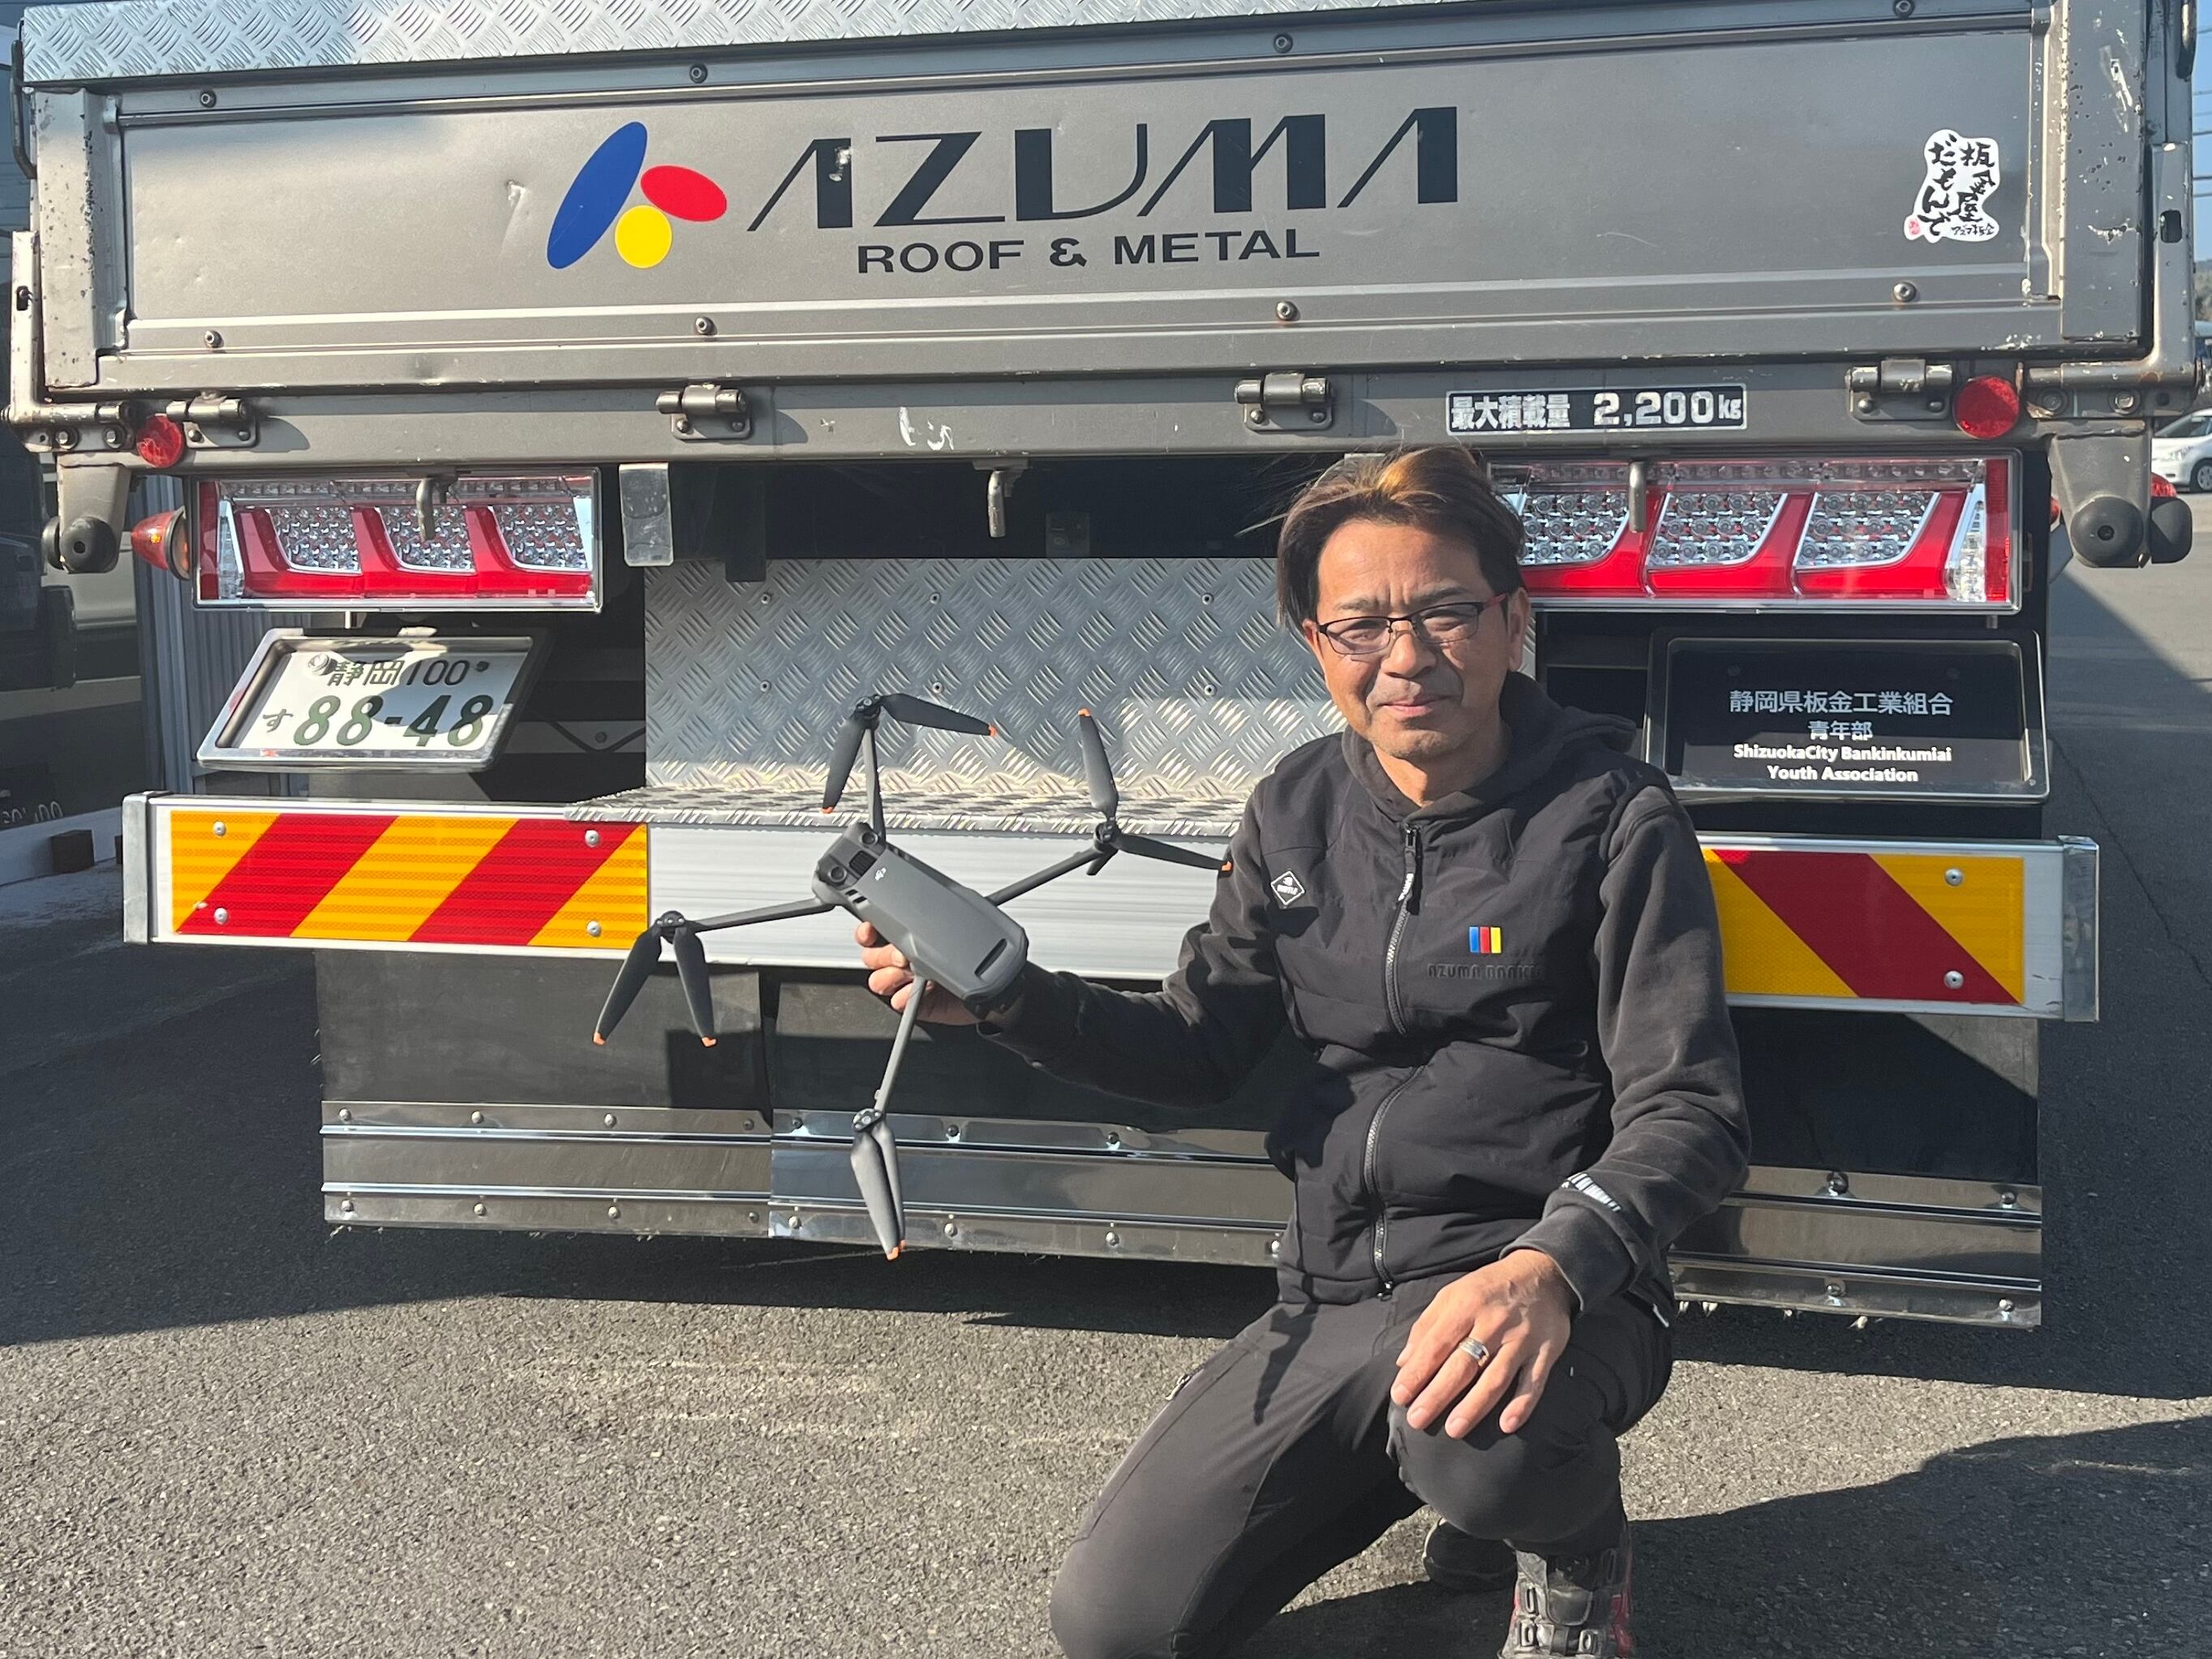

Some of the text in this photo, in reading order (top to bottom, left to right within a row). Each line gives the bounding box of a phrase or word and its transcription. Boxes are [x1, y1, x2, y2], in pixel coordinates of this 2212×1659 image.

[747, 106, 1458, 233] AZUMA
[1917, 133, 1957, 236] だもんで
[1947, 141, 1996, 223] 板金屋
[857, 227, 1321, 274] ROOF & METAL
[1450, 393, 1571, 430] 最大積載量
[293, 694, 495, 747] 88-48
[1729, 690, 1954, 716] 静岡県板金工業組合
[1807, 720, 1874, 741] 青年部
[1767, 765, 1919, 783] Youth Association
[1841, 746, 1952, 762] Bankinkumiai
